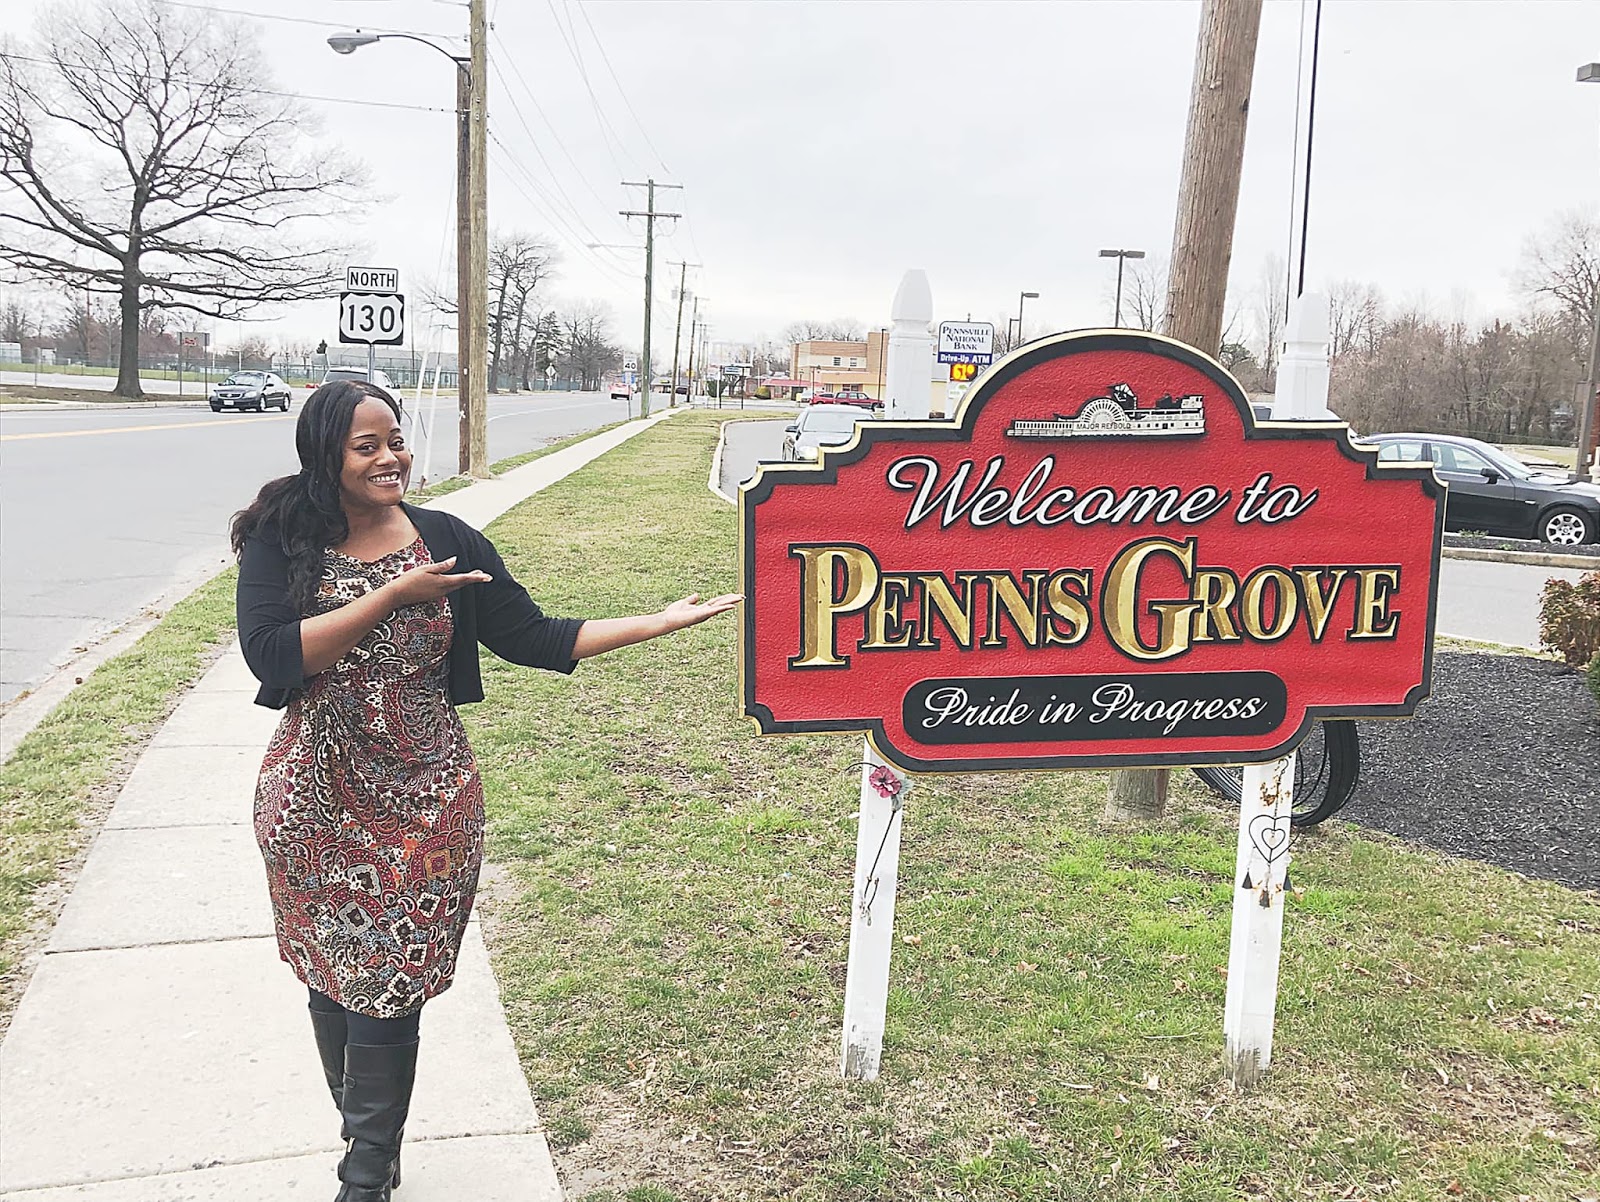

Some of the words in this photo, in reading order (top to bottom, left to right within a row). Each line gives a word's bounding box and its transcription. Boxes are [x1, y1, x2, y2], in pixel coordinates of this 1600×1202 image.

[350, 271, 395, 287] NORTH
[348, 304, 395, 333] 130
[942, 326, 989, 335] PENNSVILLE
[946, 334, 985, 343] NATIONAL
[954, 342, 978, 350] BANK
[940, 354, 970, 363] Drive-Up
[972, 355, 989, 363] ATM
[887, 454, 1231, 527] Welcome
[1235, 473, 1319, 526] to
[788, 542, 1092, 670] PENNS
[1101, 537, 1402, 662] GROVE
[922, 687, 1034, 728] Pride
[1039, 694, 1083, 724] in
[1089, 683, 1268, 735] Progress
